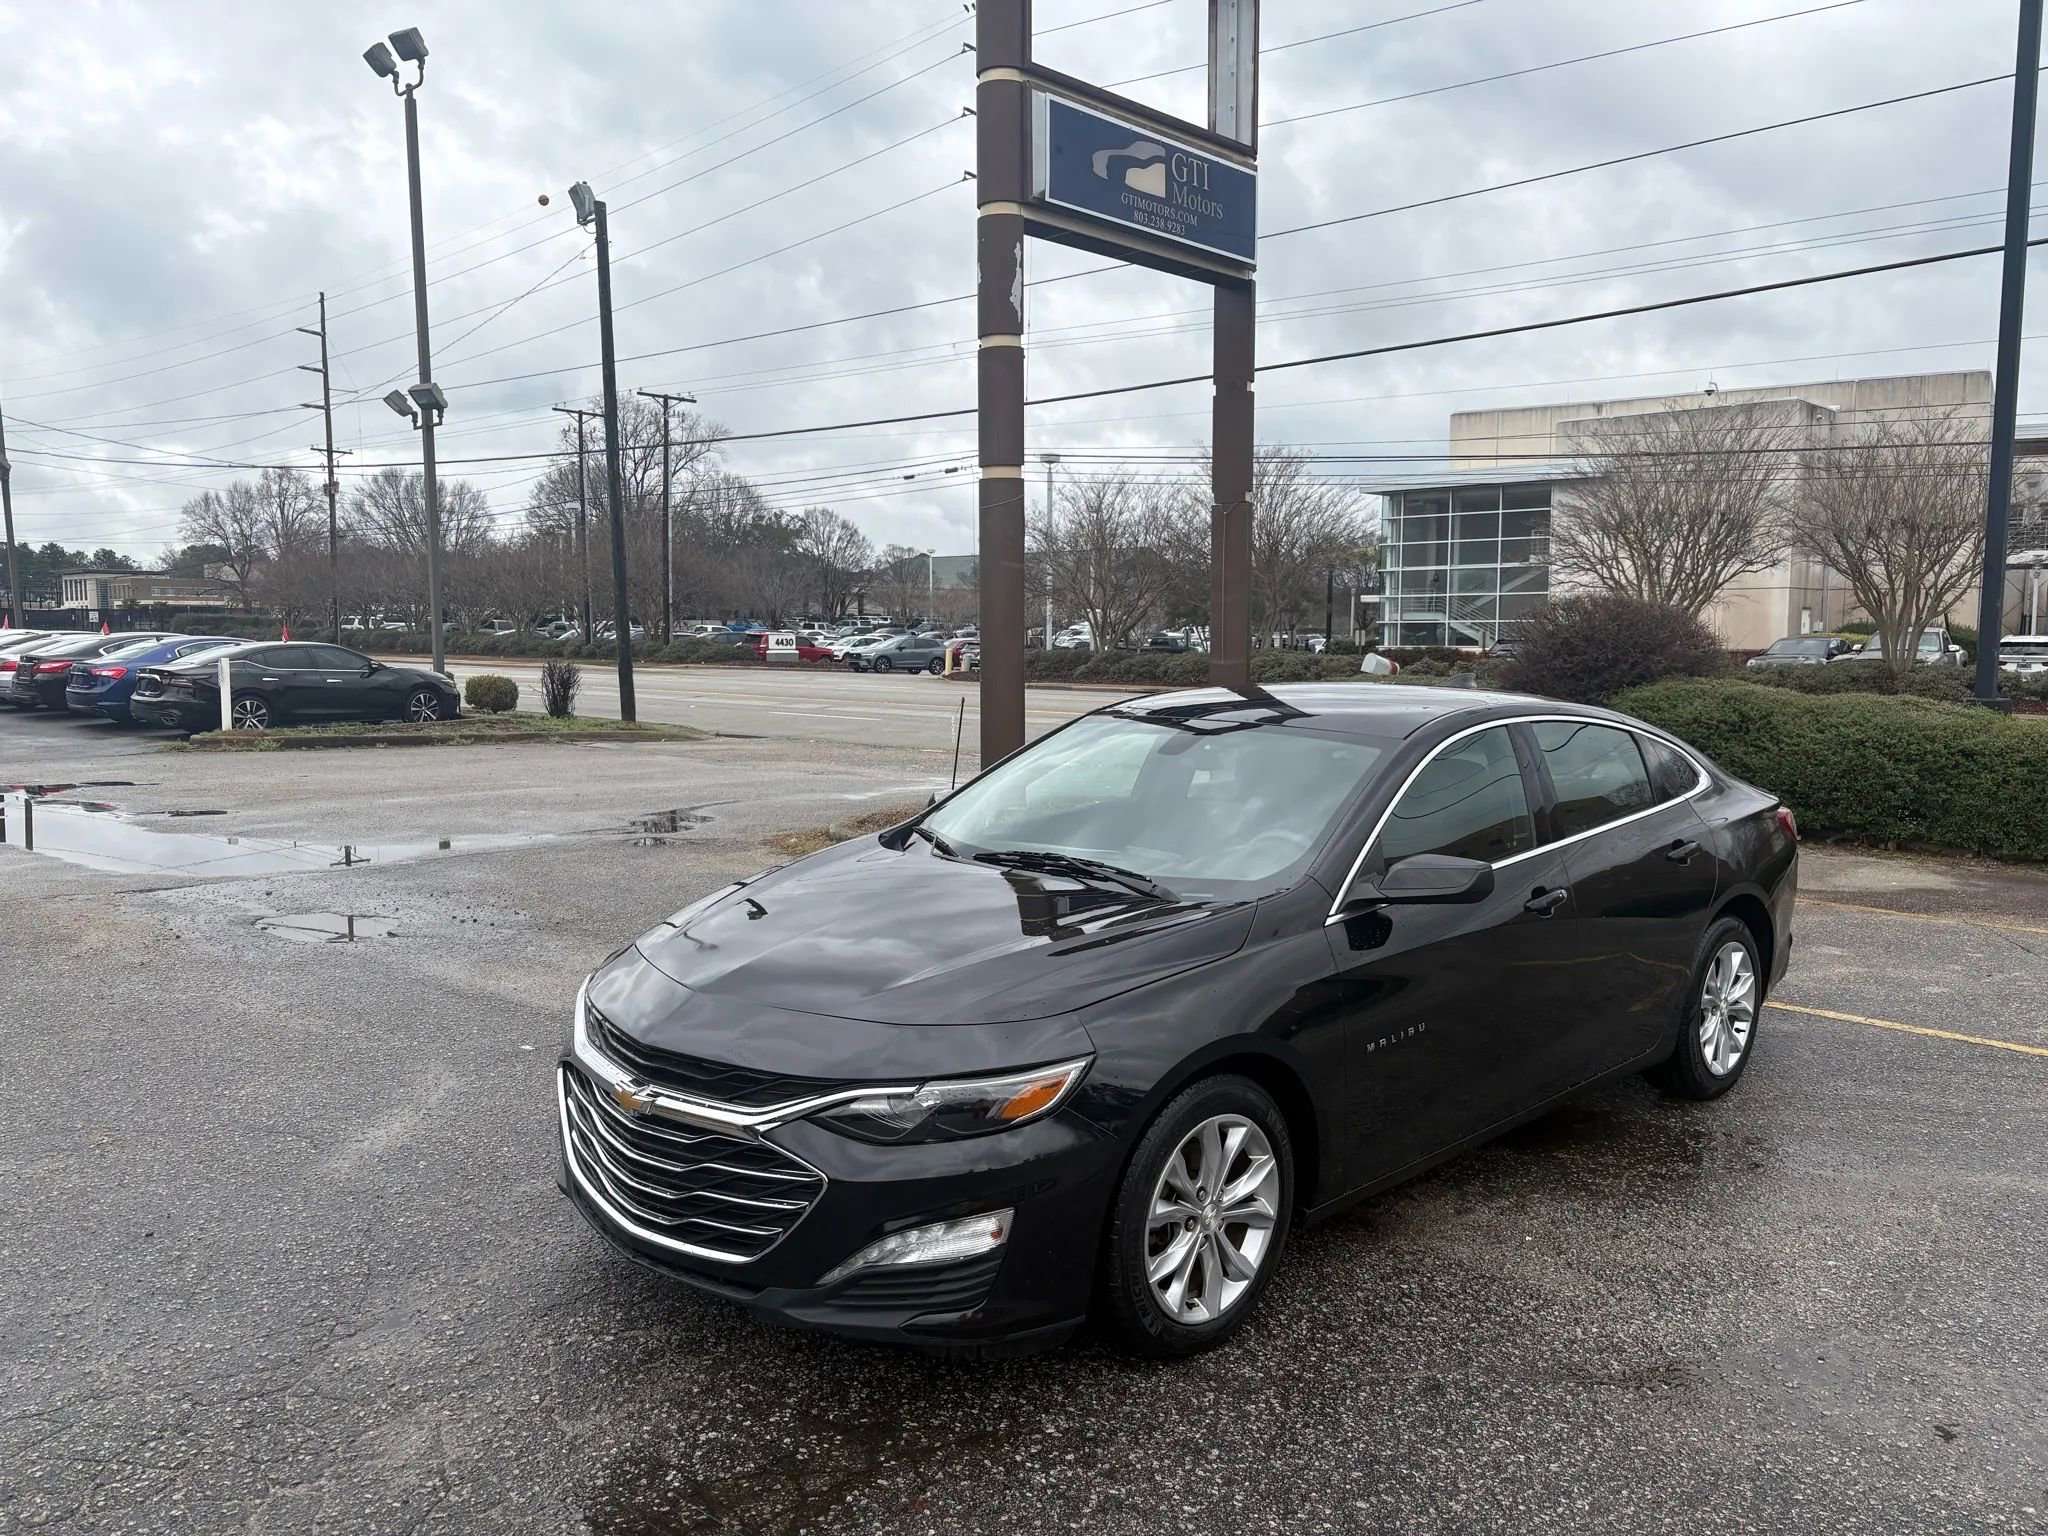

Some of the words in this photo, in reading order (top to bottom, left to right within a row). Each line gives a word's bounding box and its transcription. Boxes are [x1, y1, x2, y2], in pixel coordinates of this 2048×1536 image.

[1171, 152, 1210, 191] GTI
[1121, 192, 1198, 226] GTIMOTORS.COM
[1172, 182, 1224, 219] Motors
[1133, 210, 1186, 236] 803.238.9283
[775, 637, 794, 647] 4430
[1366, 1022, 1426, 1053] MALIBU
